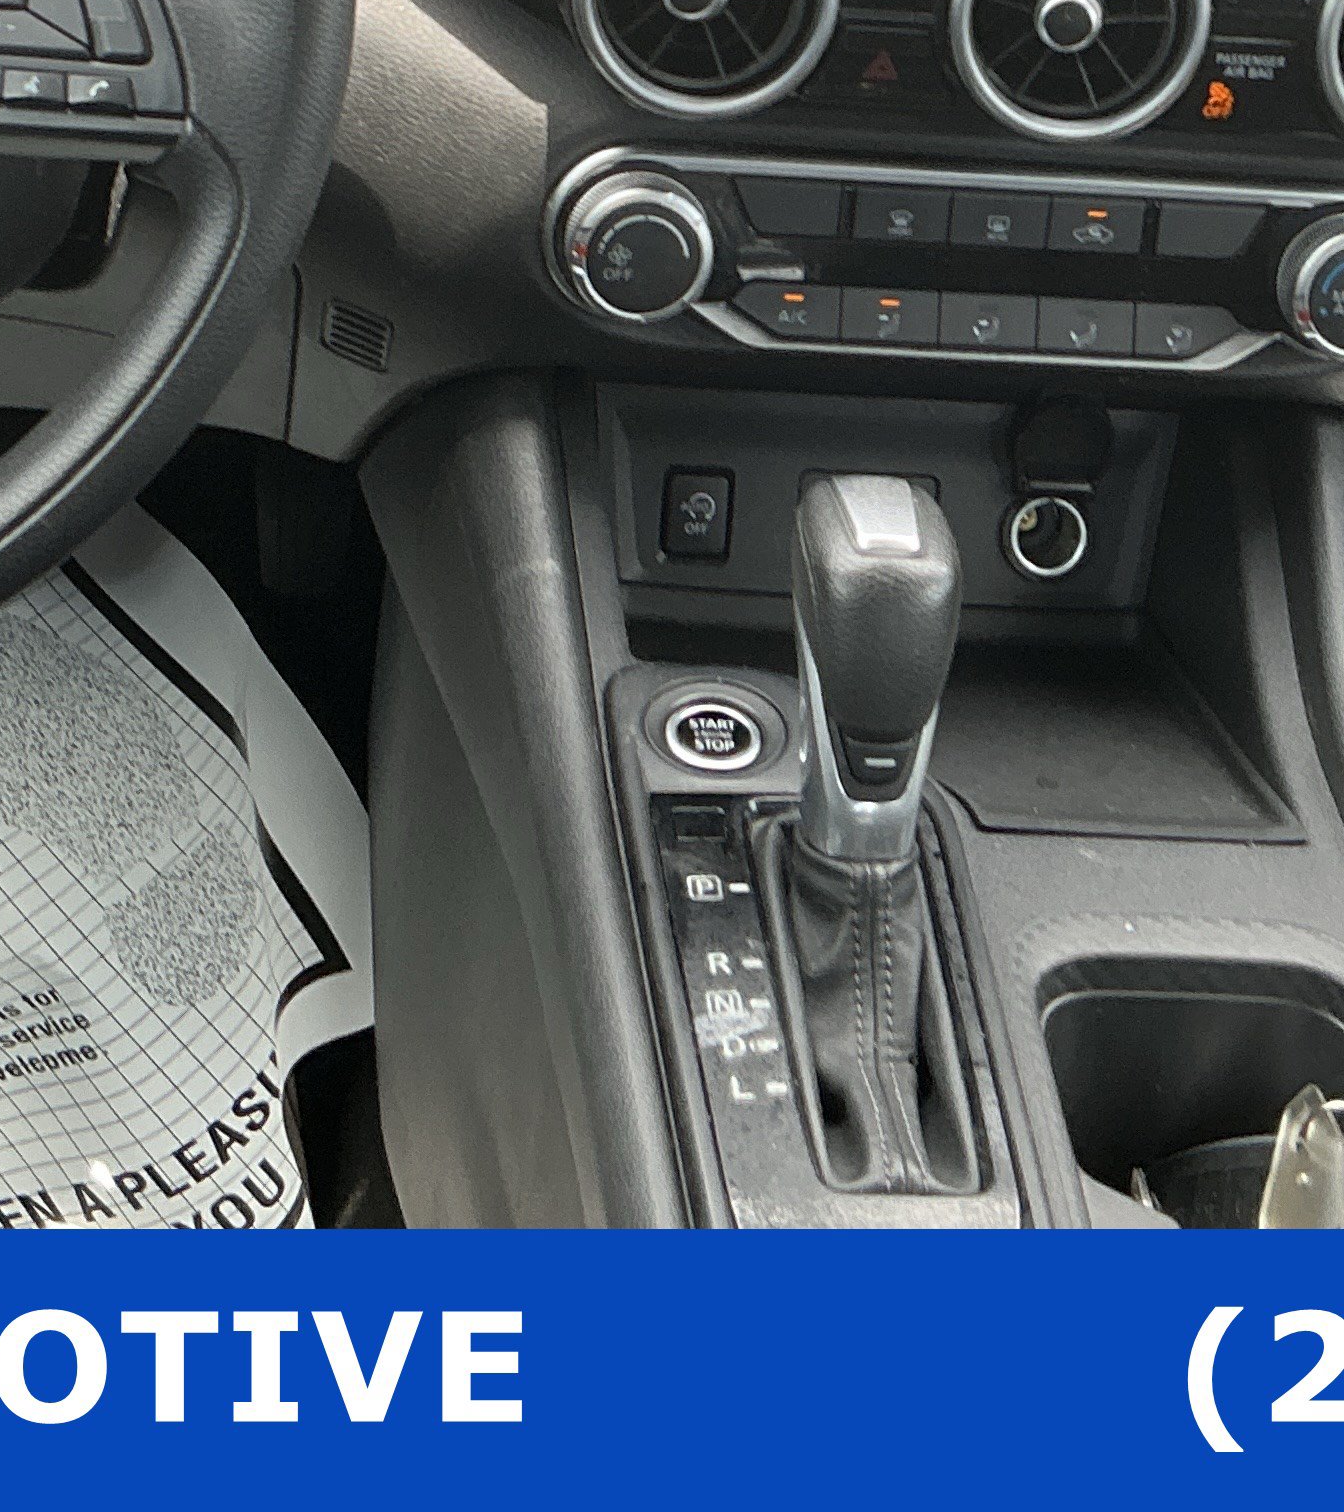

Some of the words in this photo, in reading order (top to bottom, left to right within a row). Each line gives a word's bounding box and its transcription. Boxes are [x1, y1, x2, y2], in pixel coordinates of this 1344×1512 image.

[1216, 52, 1287, 69] PASSENGER
[1222, 67, 1245, 79] AIR
[1247, 67, 1274, 81] BAG
[602, 266, 635, 283] OFF
[777, 308, 808, 325] A/C
[683, 522, 708, 537] OFF
[688, 717, 735, 732] START
[694, 737, 736, 753] STOP
[707, 951, 732, 975] R
[20, 987, 61, 1011] for
[730, 1075, 756, 1100] L
[72, 1181, 117, 1222] A
